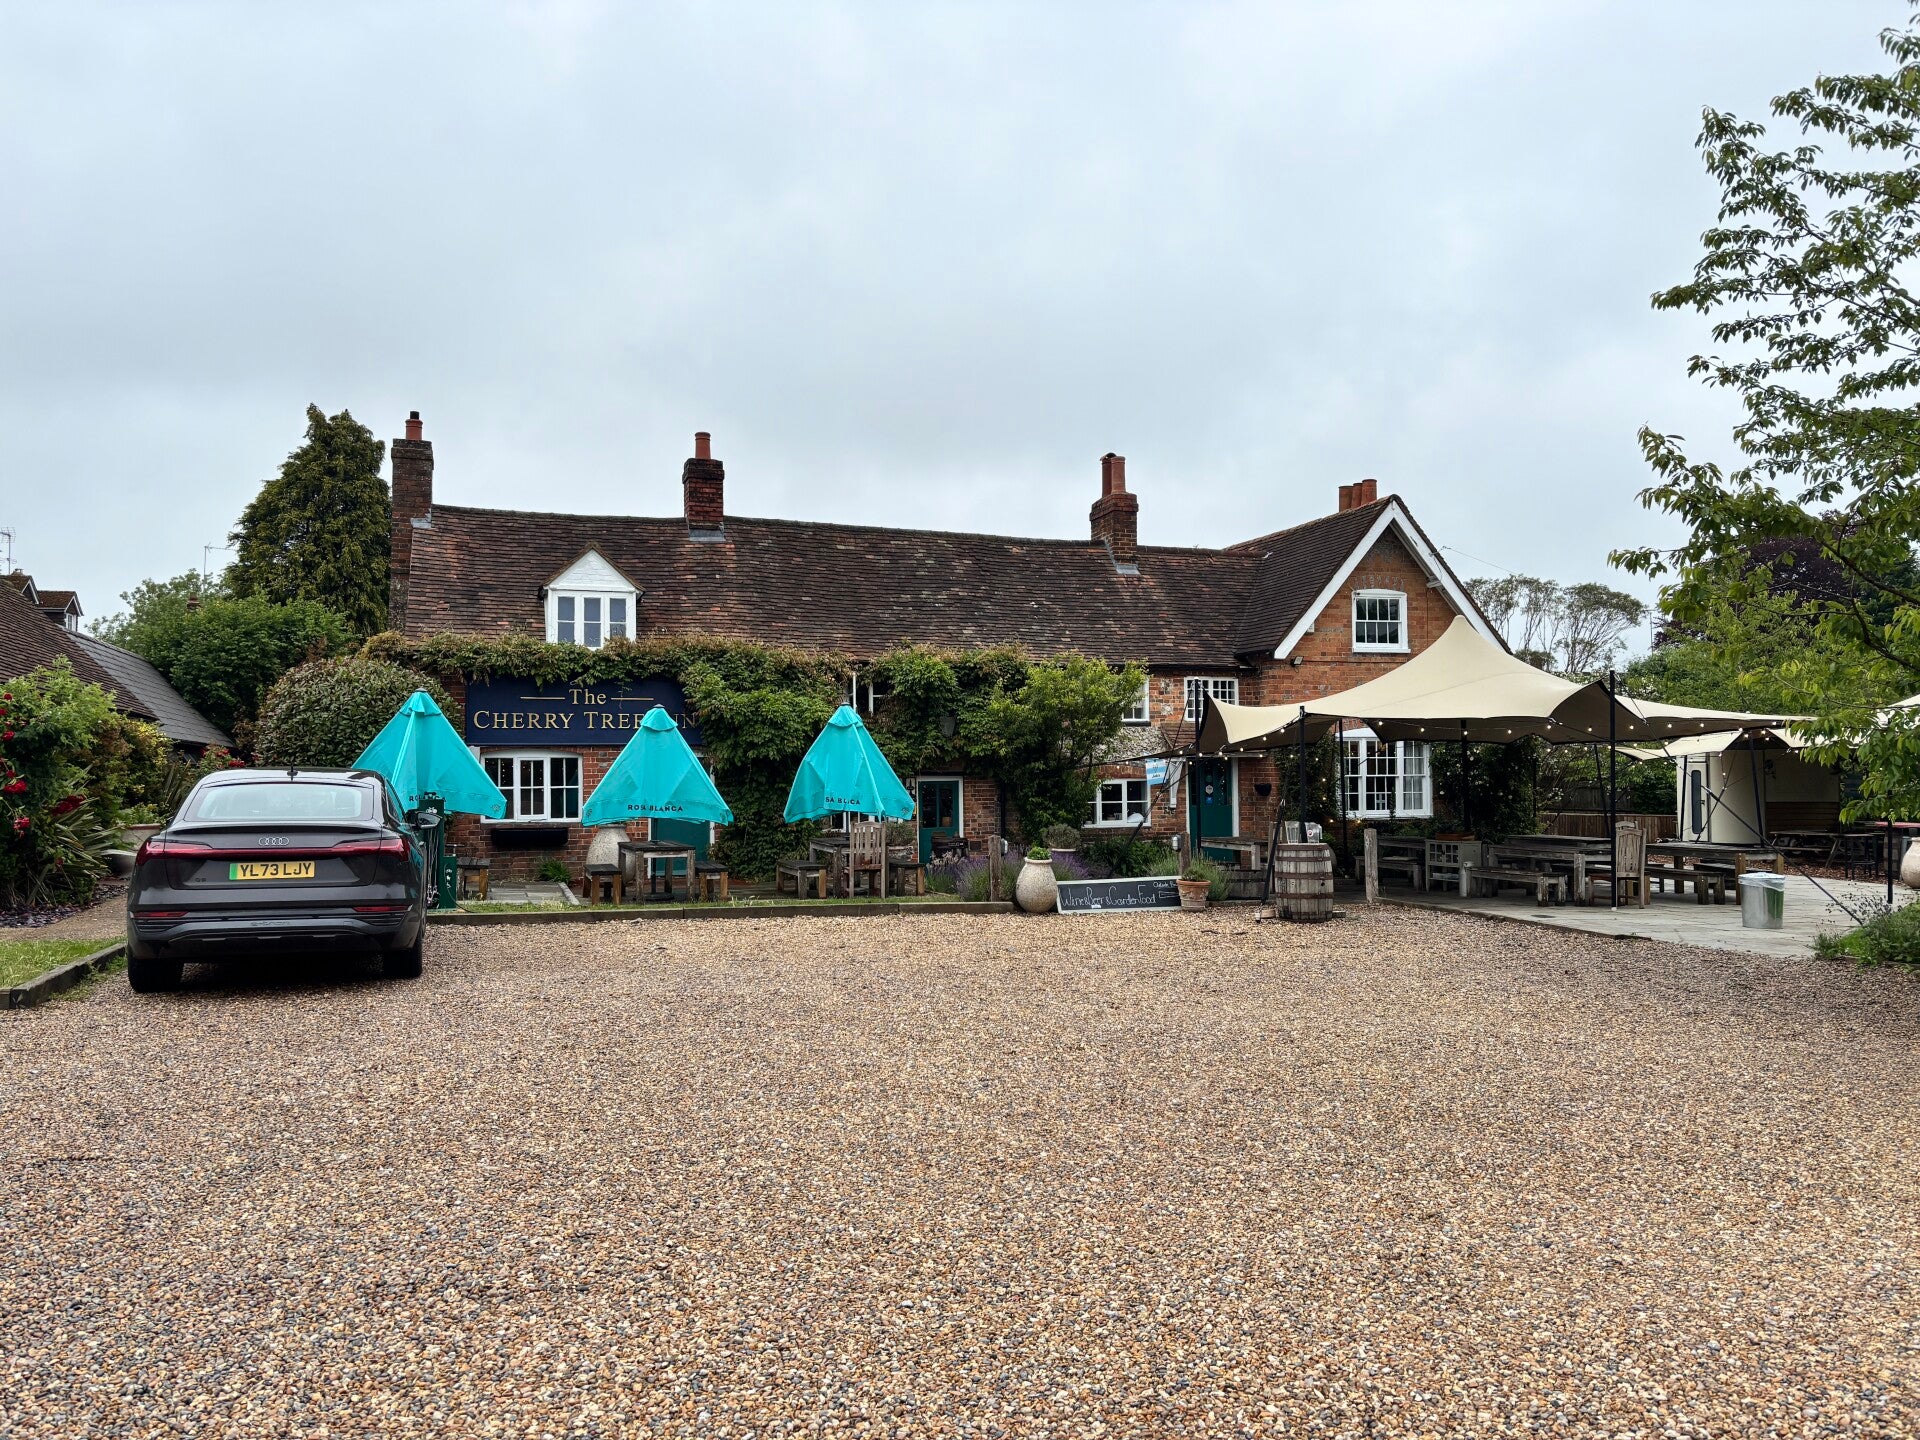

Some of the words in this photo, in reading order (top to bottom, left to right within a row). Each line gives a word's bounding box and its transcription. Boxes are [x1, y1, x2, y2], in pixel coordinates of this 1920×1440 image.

[569, 689, 606, 704] The
[473, 710, 575, 729] CHERRY
[240, 863, 279, 877] YL73
[283, 862, 312, 876] LJY
